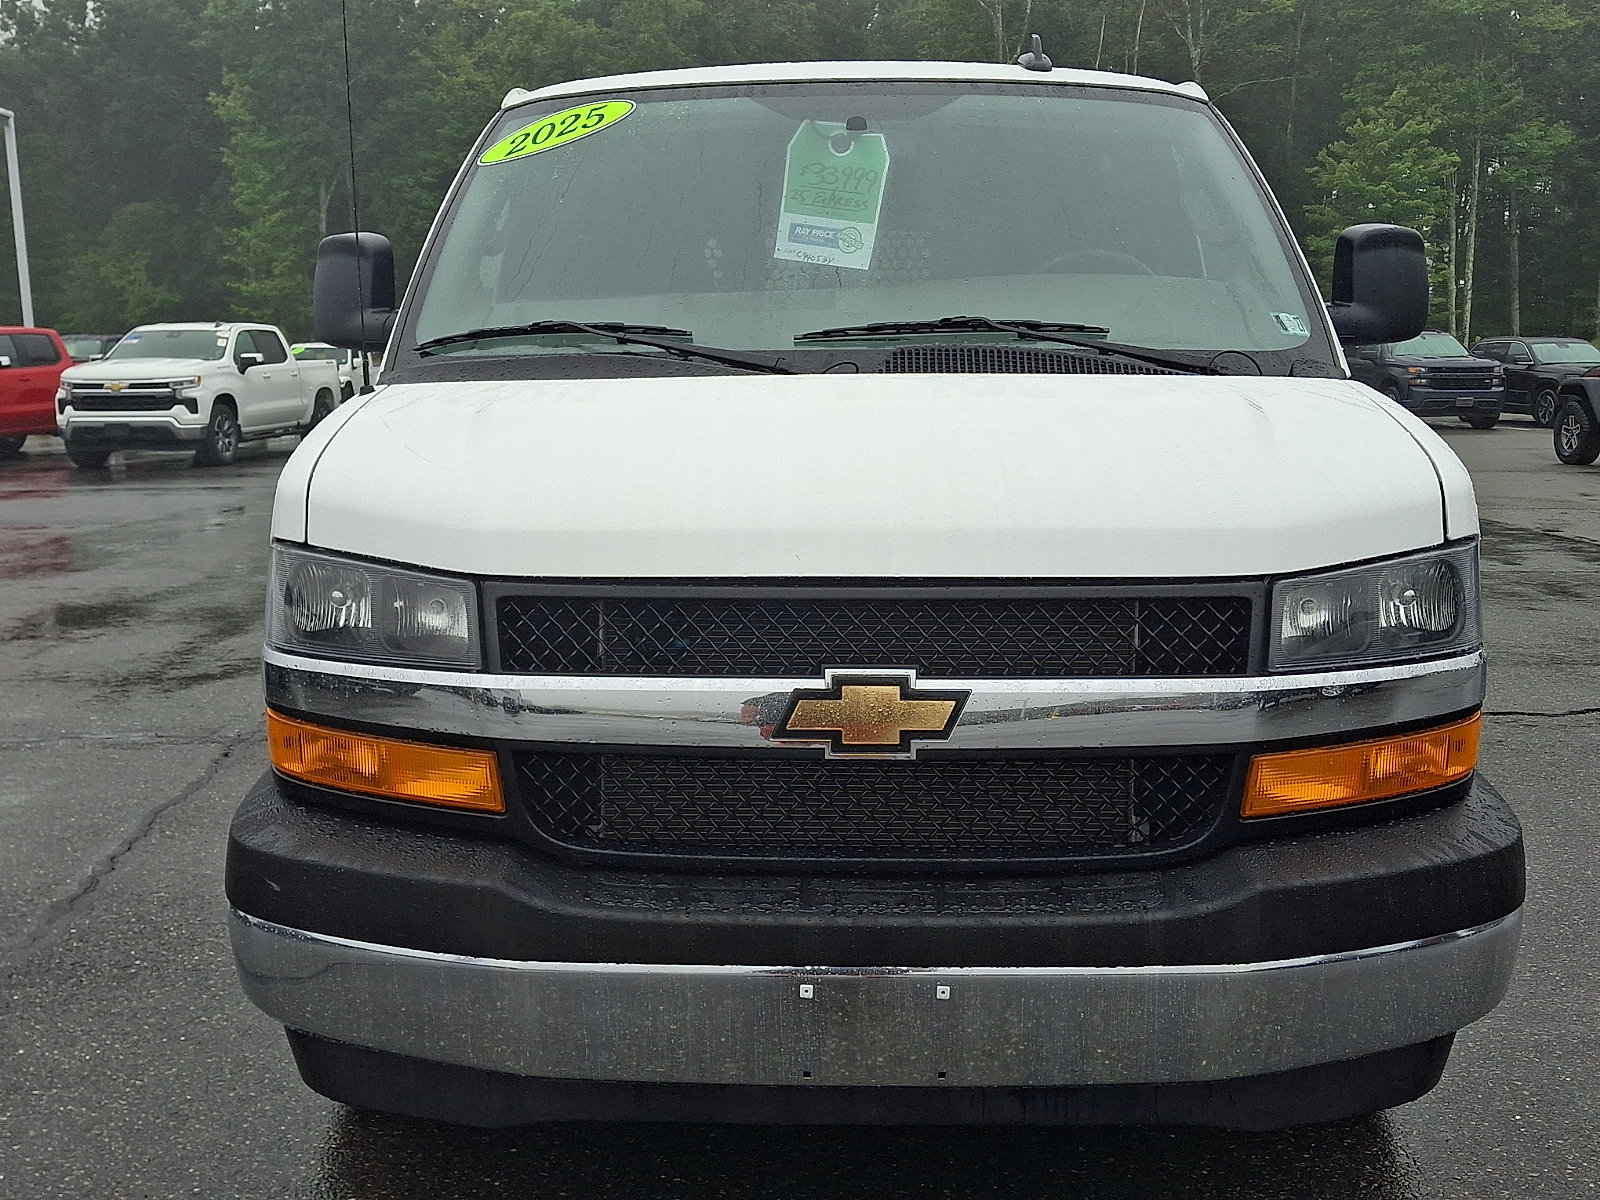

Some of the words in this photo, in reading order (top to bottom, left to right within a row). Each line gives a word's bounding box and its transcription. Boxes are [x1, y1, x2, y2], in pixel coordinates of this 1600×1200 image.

[504, 104, 608, 157] 2025
[799, 162, 878, 193] $33999
[794, 226, 812, 236] RAY
